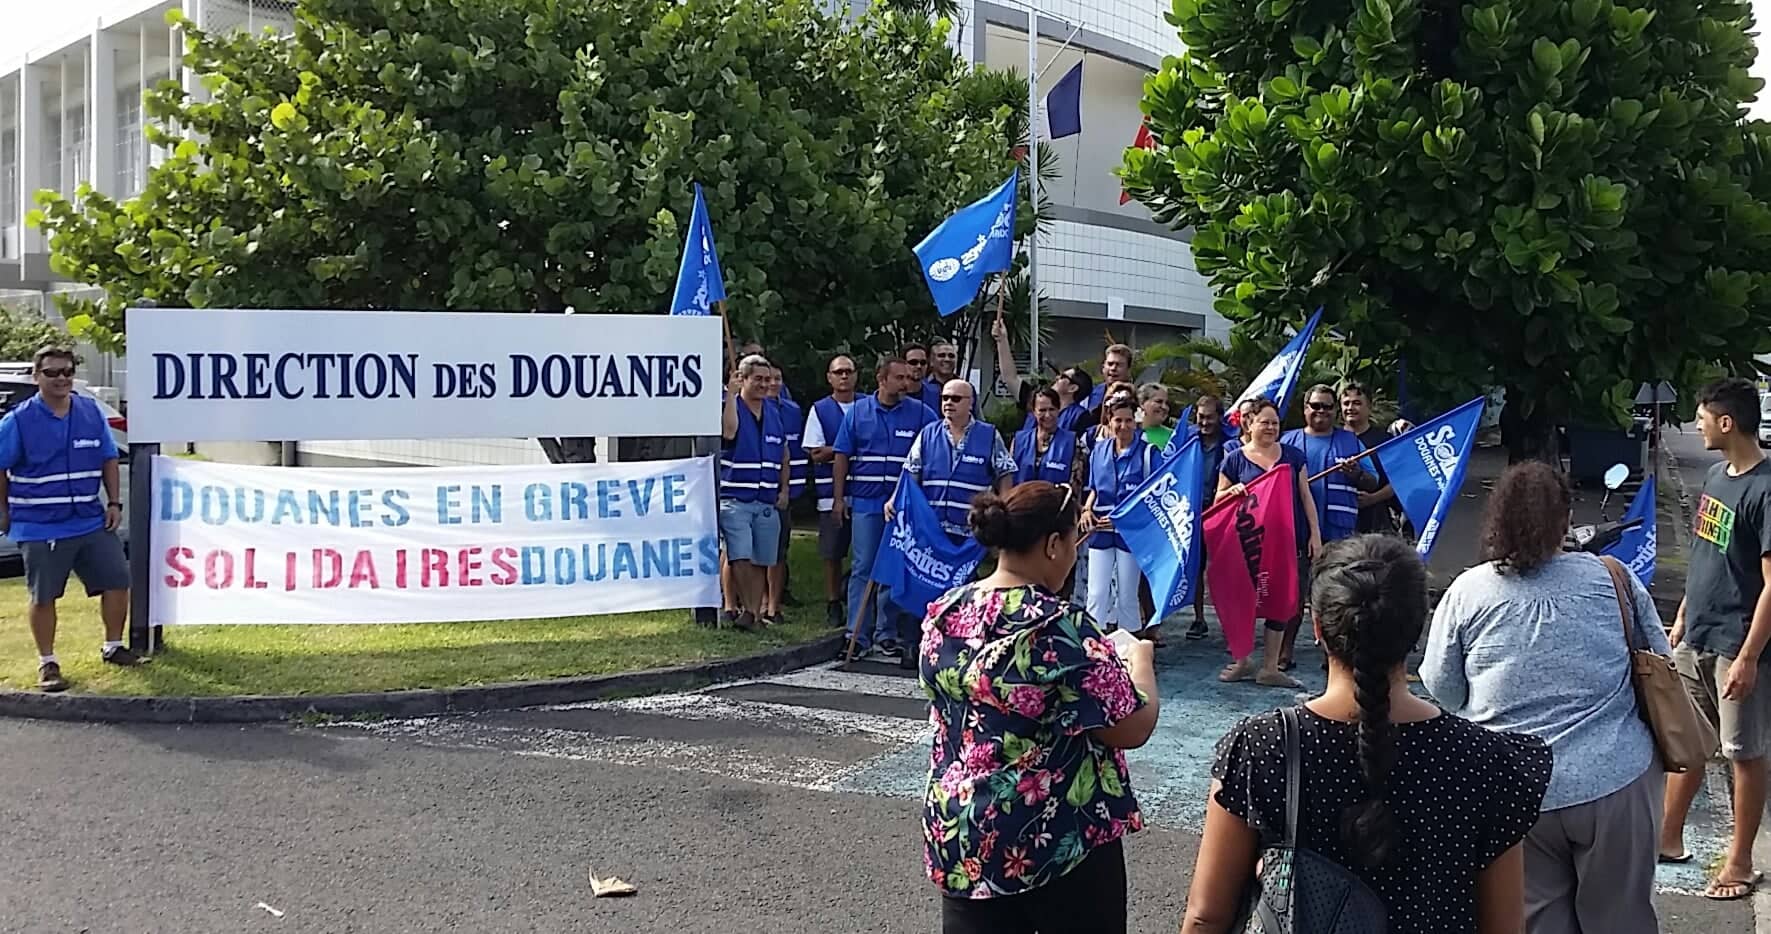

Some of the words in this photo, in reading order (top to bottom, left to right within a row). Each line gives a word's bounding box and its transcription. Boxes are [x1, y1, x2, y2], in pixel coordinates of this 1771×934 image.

[152, 353, 419, 400] DIRECTION
[433, 364, 497, 400] DES
[509, 354, 703, 399] DOUANES
[160, 477, 410, 528] DOUANES
[436, 484, 502, 525] EN
[523, 474, 687, 522] GREVE
[1143, 493, 1170, 529] OUANES
[164, 545, 519, 592] SOLIDAIRES
[520, 536, 720, 585] DOUANES
